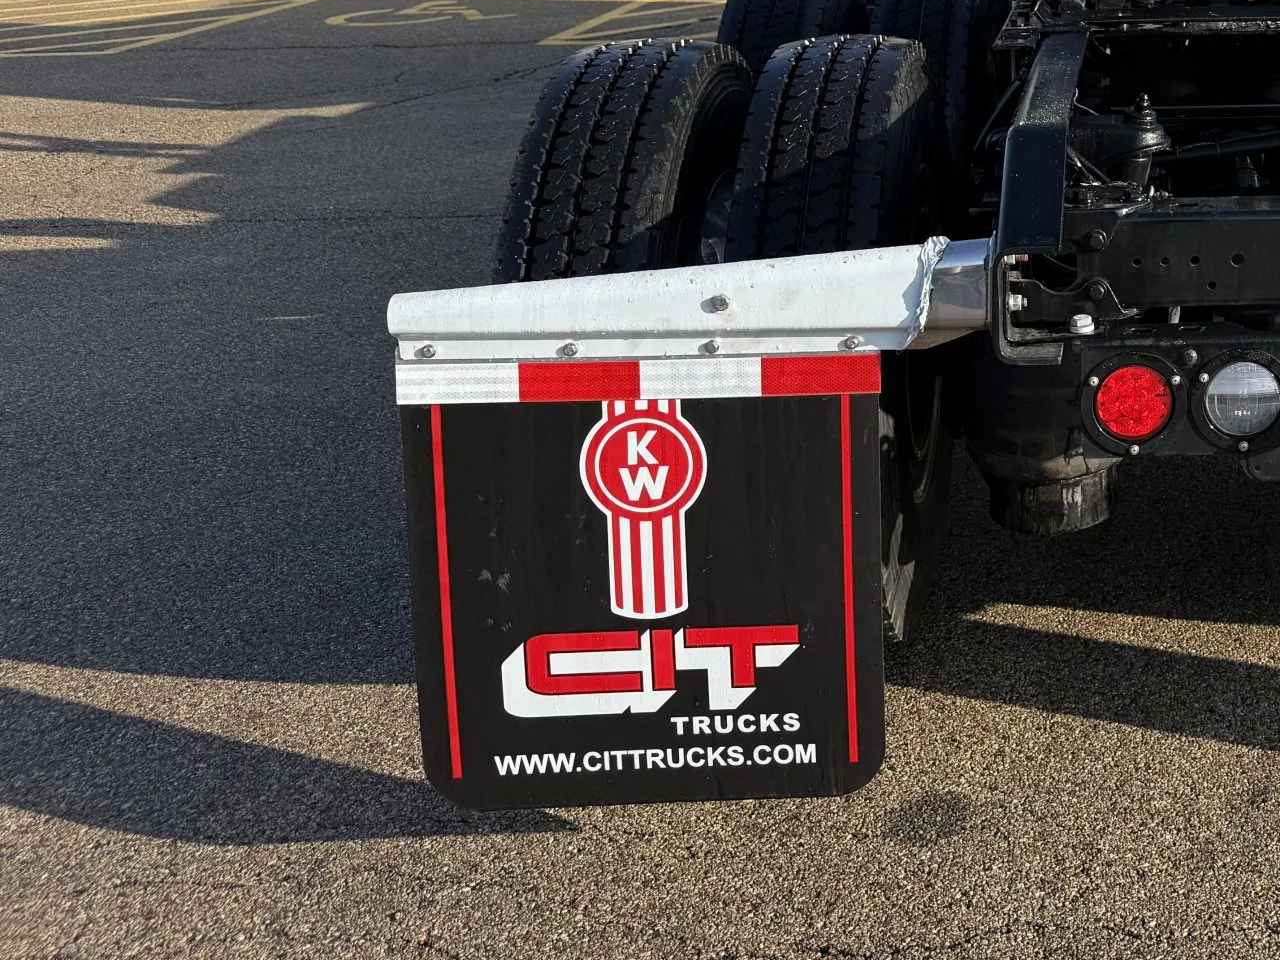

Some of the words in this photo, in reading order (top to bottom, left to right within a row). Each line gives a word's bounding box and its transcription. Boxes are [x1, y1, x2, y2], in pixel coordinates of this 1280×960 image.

[501, 624, 800, 717] CIT
[670, 712, 802, 736] TRUCKS
[493, 743, 818, 776] WWW.CITTRUCKS.COM
